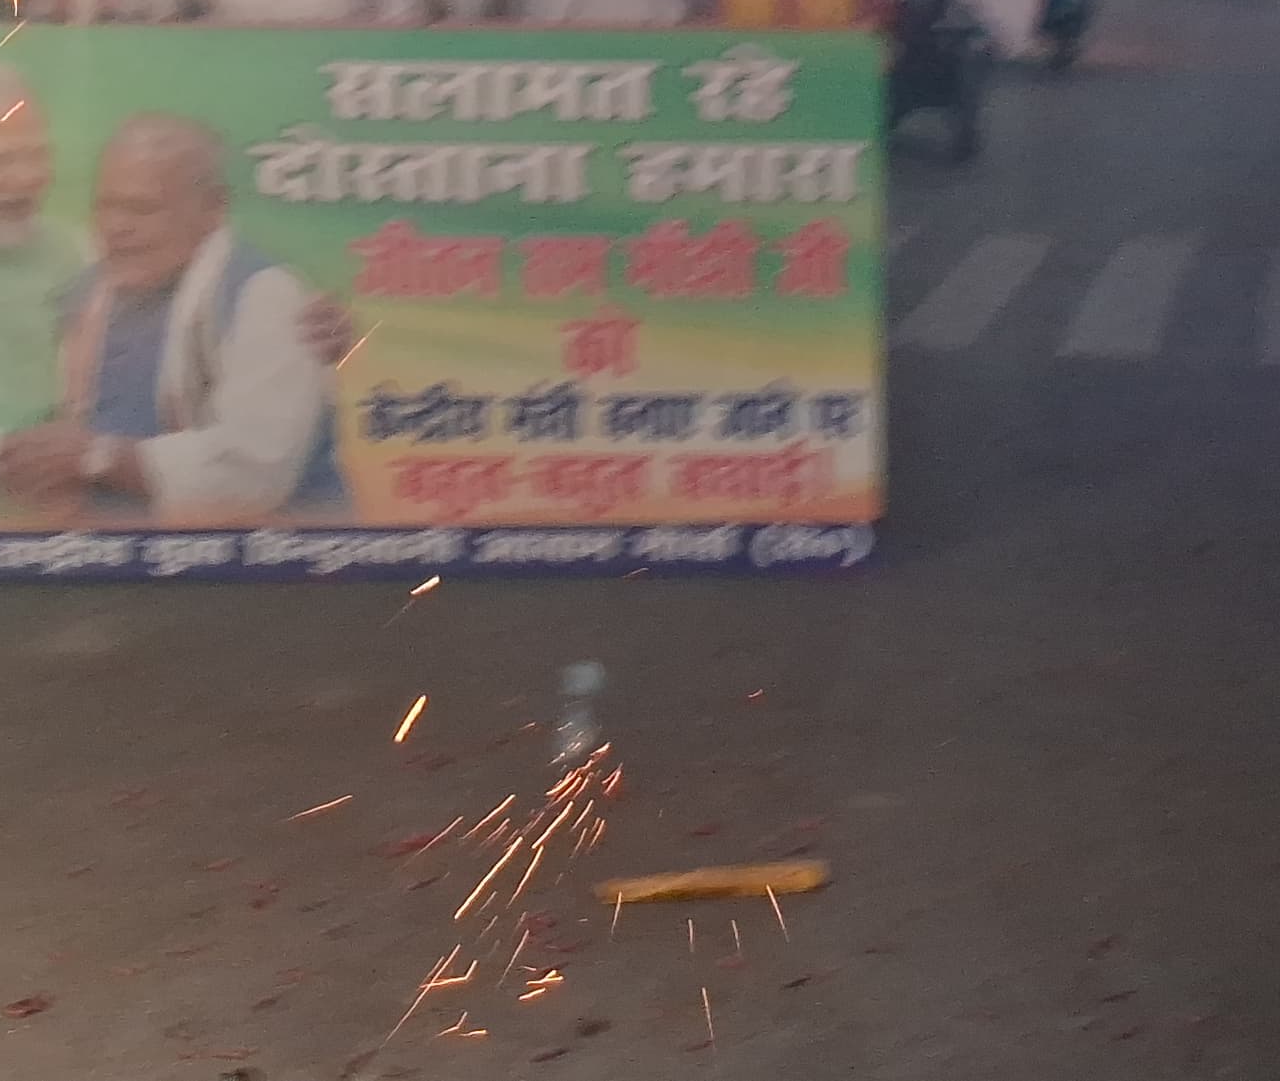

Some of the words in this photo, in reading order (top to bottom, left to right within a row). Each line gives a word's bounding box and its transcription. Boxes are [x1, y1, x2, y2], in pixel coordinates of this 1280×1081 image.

[322, 57, 664, 119] सलामत
[684, 40, 800, 119] रहे
[246, 123, 594, 204] दोस्ताना
[619, 141, 866, 203] हमारा
[350, 220, 506, 297] जीतन
[774, 220, 850, 297] जी
[562, 306, 641, 377] को
